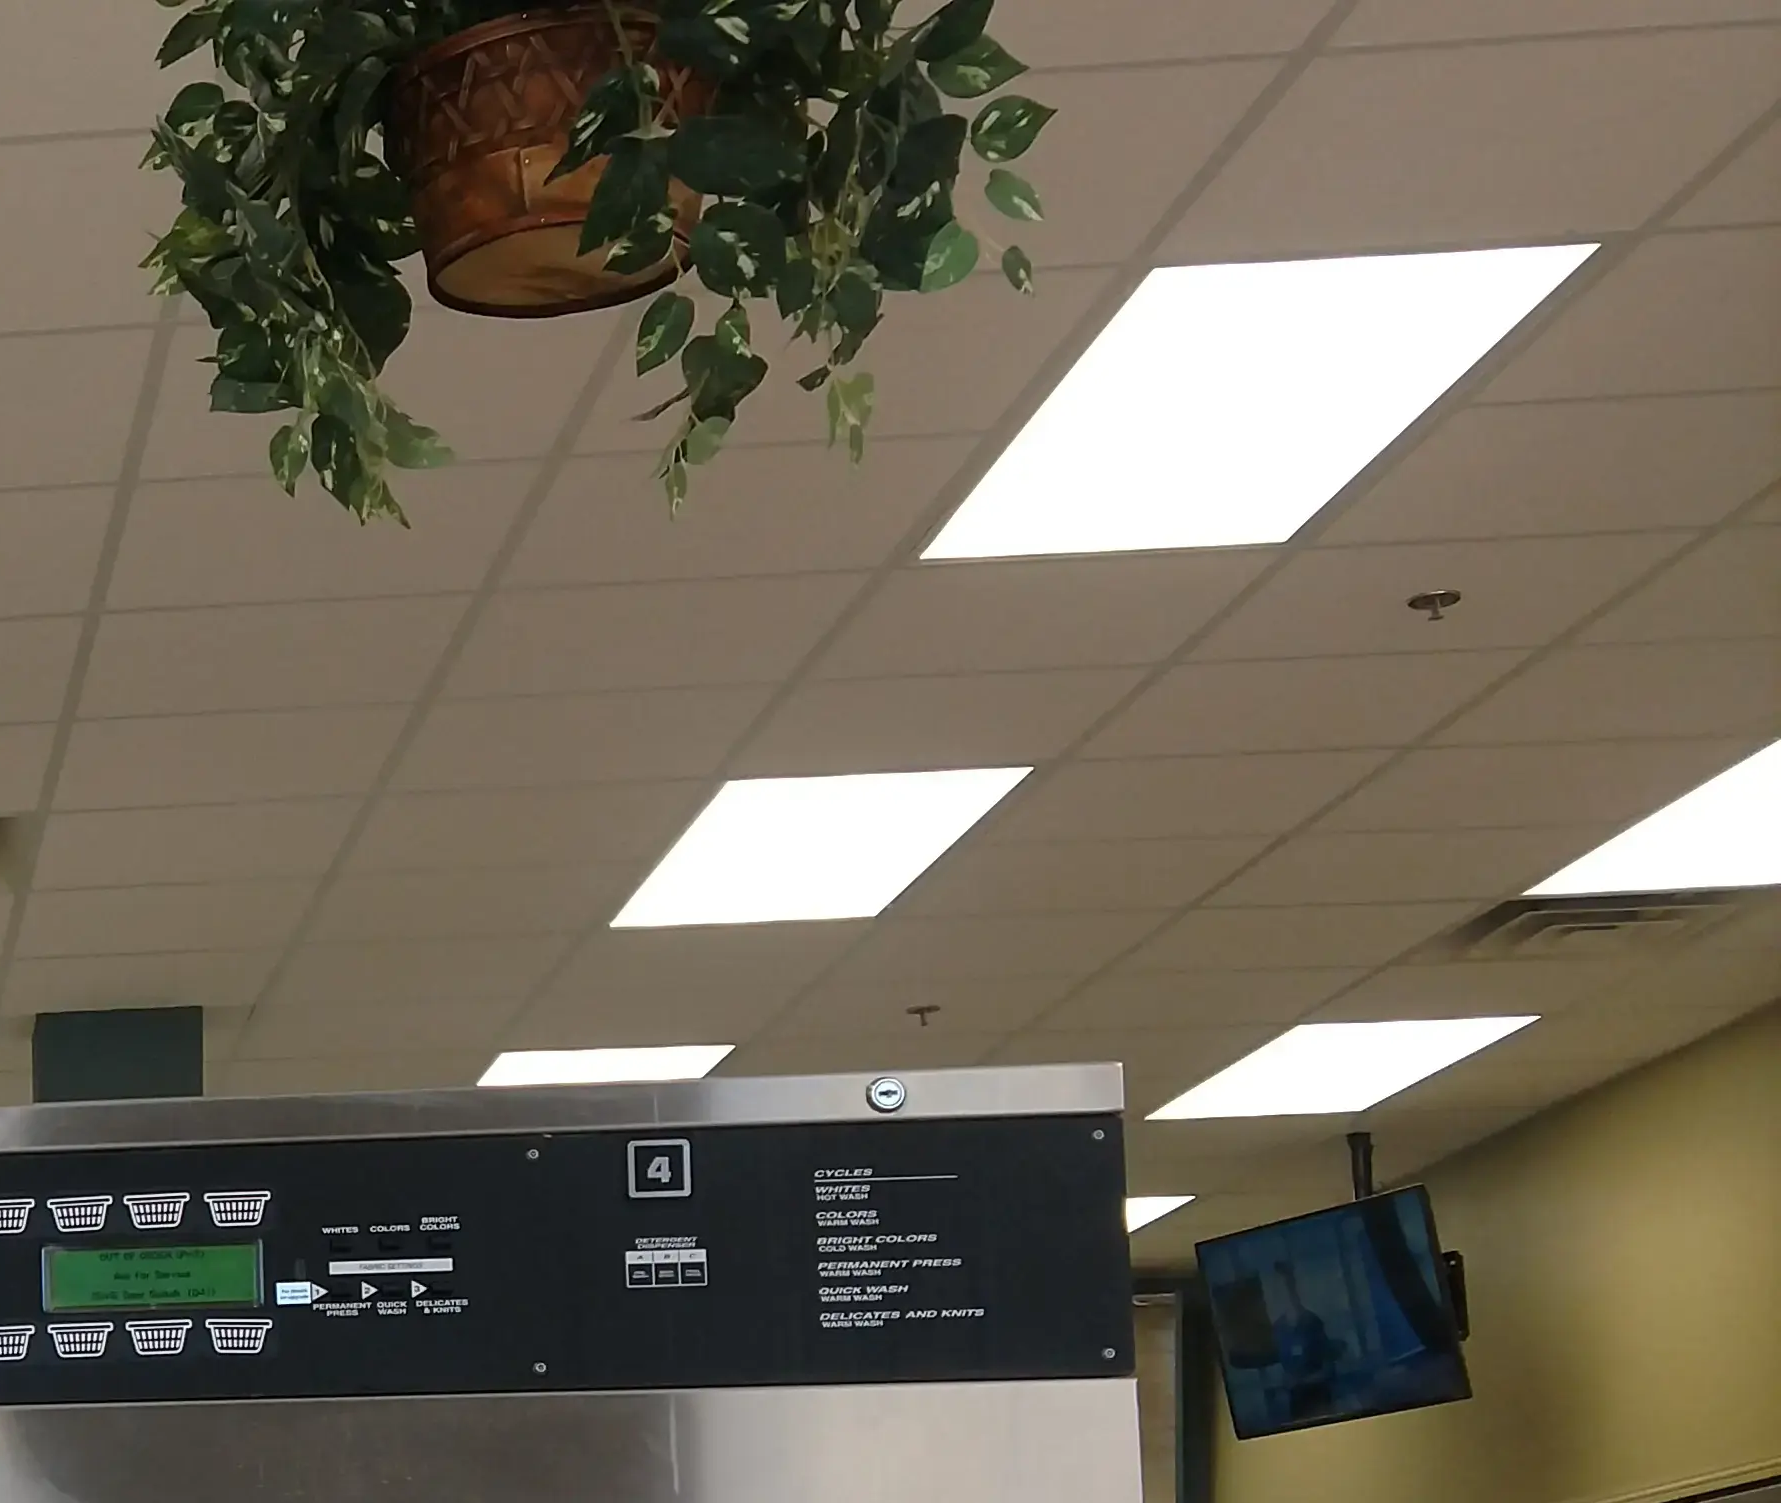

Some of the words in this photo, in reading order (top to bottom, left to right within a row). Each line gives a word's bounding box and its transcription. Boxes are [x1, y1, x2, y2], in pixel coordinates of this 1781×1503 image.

[647, 1157, 671, 1183] 4
[814, 1168, 873, 1177] CYCLES
[815, 1185, 870, 1193] WHITES
[816, 1210, 877, 1219] COLORS
[421, 1216, 458, 1224] BRIGHT
[420, 1223, 460, 1231] COLORS
[635, 1236, 697, 1244] DETERGENT
[817, 1236, 872, 1245] BRIGHT
[875, 1234, 937, 1243] COLORS
[818, 1260, 909, 1270] PERMANENT
[912, 1259, 962, 1268] PRESS
[819, 1287, 861, 1295] QUICK
[866, 1285, 909, 1293] WASH
[313, 1302, 372, 1310] PERMANENT
[416, 1299, 468, 1307] DELICATES
[326, 1309, 358, 1317] PRESS
[820, 1311, 900, 1321] DELICATES
[906, 1310, 937, 1318] AND
[941, 1309, 985, 1317] KNITS
